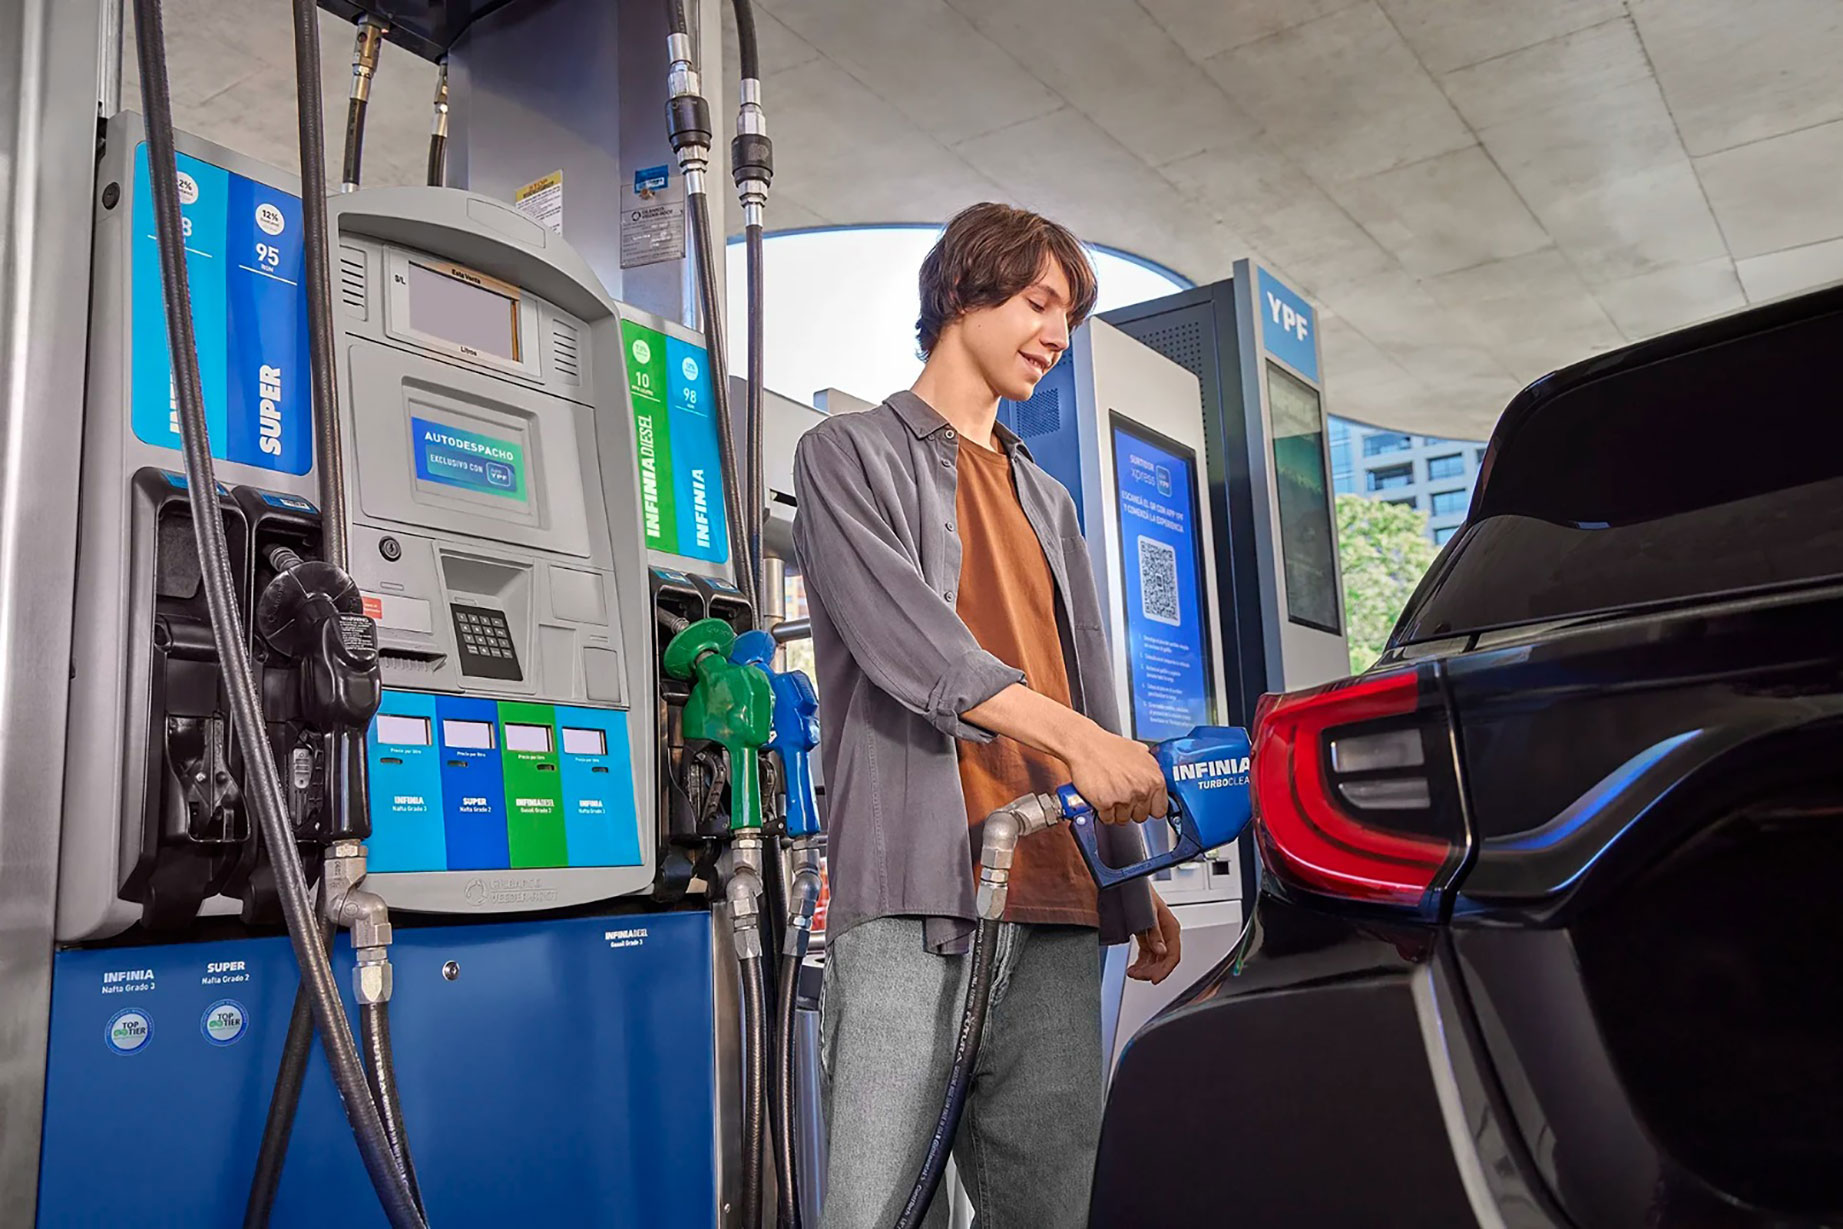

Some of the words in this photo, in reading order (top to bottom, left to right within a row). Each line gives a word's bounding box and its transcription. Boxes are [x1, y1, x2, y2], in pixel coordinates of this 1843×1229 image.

[262, 209, 279, 222] 12%
[181, 216, 193, 237] 8
[255, 242, 280, 267] 95
[1266, 290, 1308, 342] YPF
[635, 371, 650, 389] 10
[683, 387, 697, 404] 98
[259, 364, 281, 456] SUPER
[425, 431, 514, 461] AUTODESPACHO
[430, 454, 468, 470] EXCLUSIVO
[469, 463, 483, 473] CON
[692, 468, 710, 549] INFINIA
[1172, 756, 1250, 782] INFINIA
[1197, 775, 1250, 790] TURBOCLEA
[463, 797, 487, 805] SUPER
[207, 961, 245, 974] SUPER
[103, 969, 155, 984] INFINIA
[201, 976, 221, 985] Nafta
[221, 975, 244, 984] Grado
[101, 984, 124, 995] Nafta
[125, 982, 149, 992] Grado
[150, 982, 156, 990] 3
[217, 1012, 234, 1021] TOP
[223, 1019, 241, 1027] TIER
[122, 1021, 139, 1029] TOP
[129, 1028, 146, 1036] TIER
